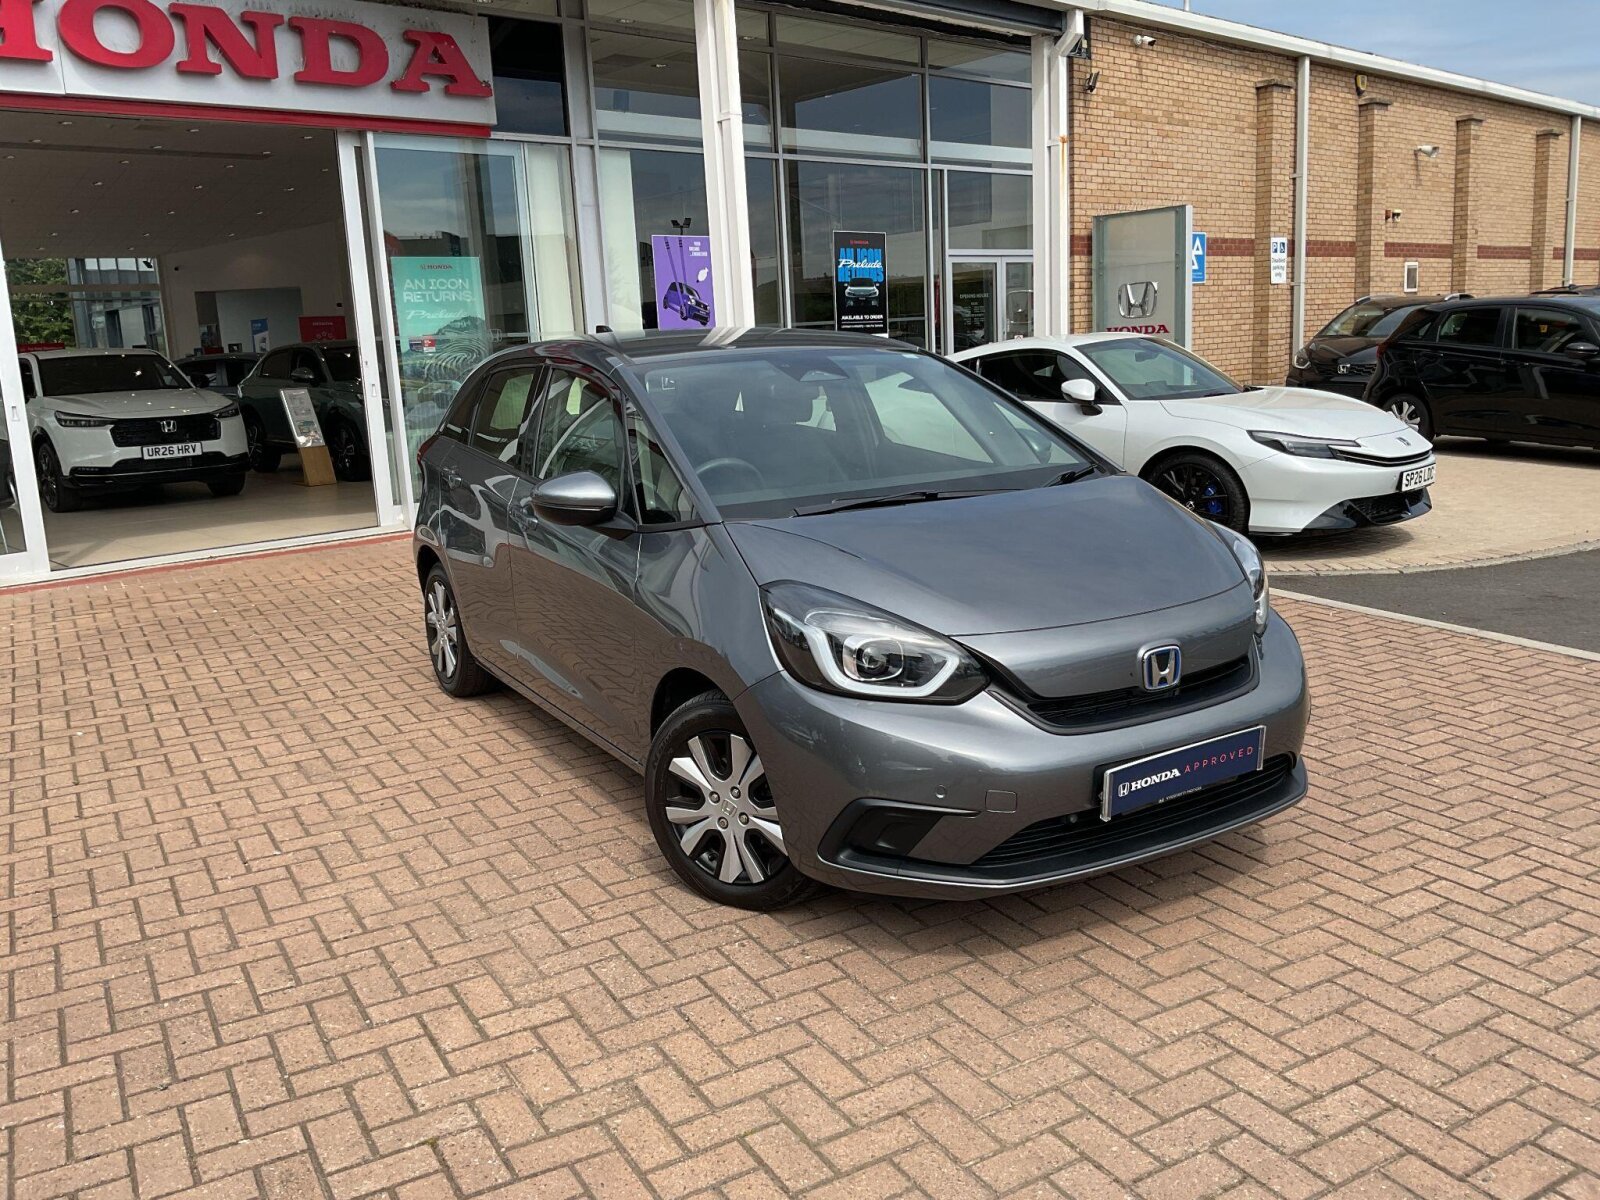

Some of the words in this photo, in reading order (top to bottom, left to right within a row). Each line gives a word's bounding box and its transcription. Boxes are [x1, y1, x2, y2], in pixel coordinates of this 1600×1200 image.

[838, 258, 883, 268] Prelude
[403, 279, 426, 291] AN
[428, 278, 470, 290] ICON
[147, 446, 174, 457] UR26
[177, 444, 197, 455] HRV
[1405, 470, 1423, 487] SP26
[1130, 768, 1181, 792] HONDA
[1184, 746, 1254, 774] APPROVED
